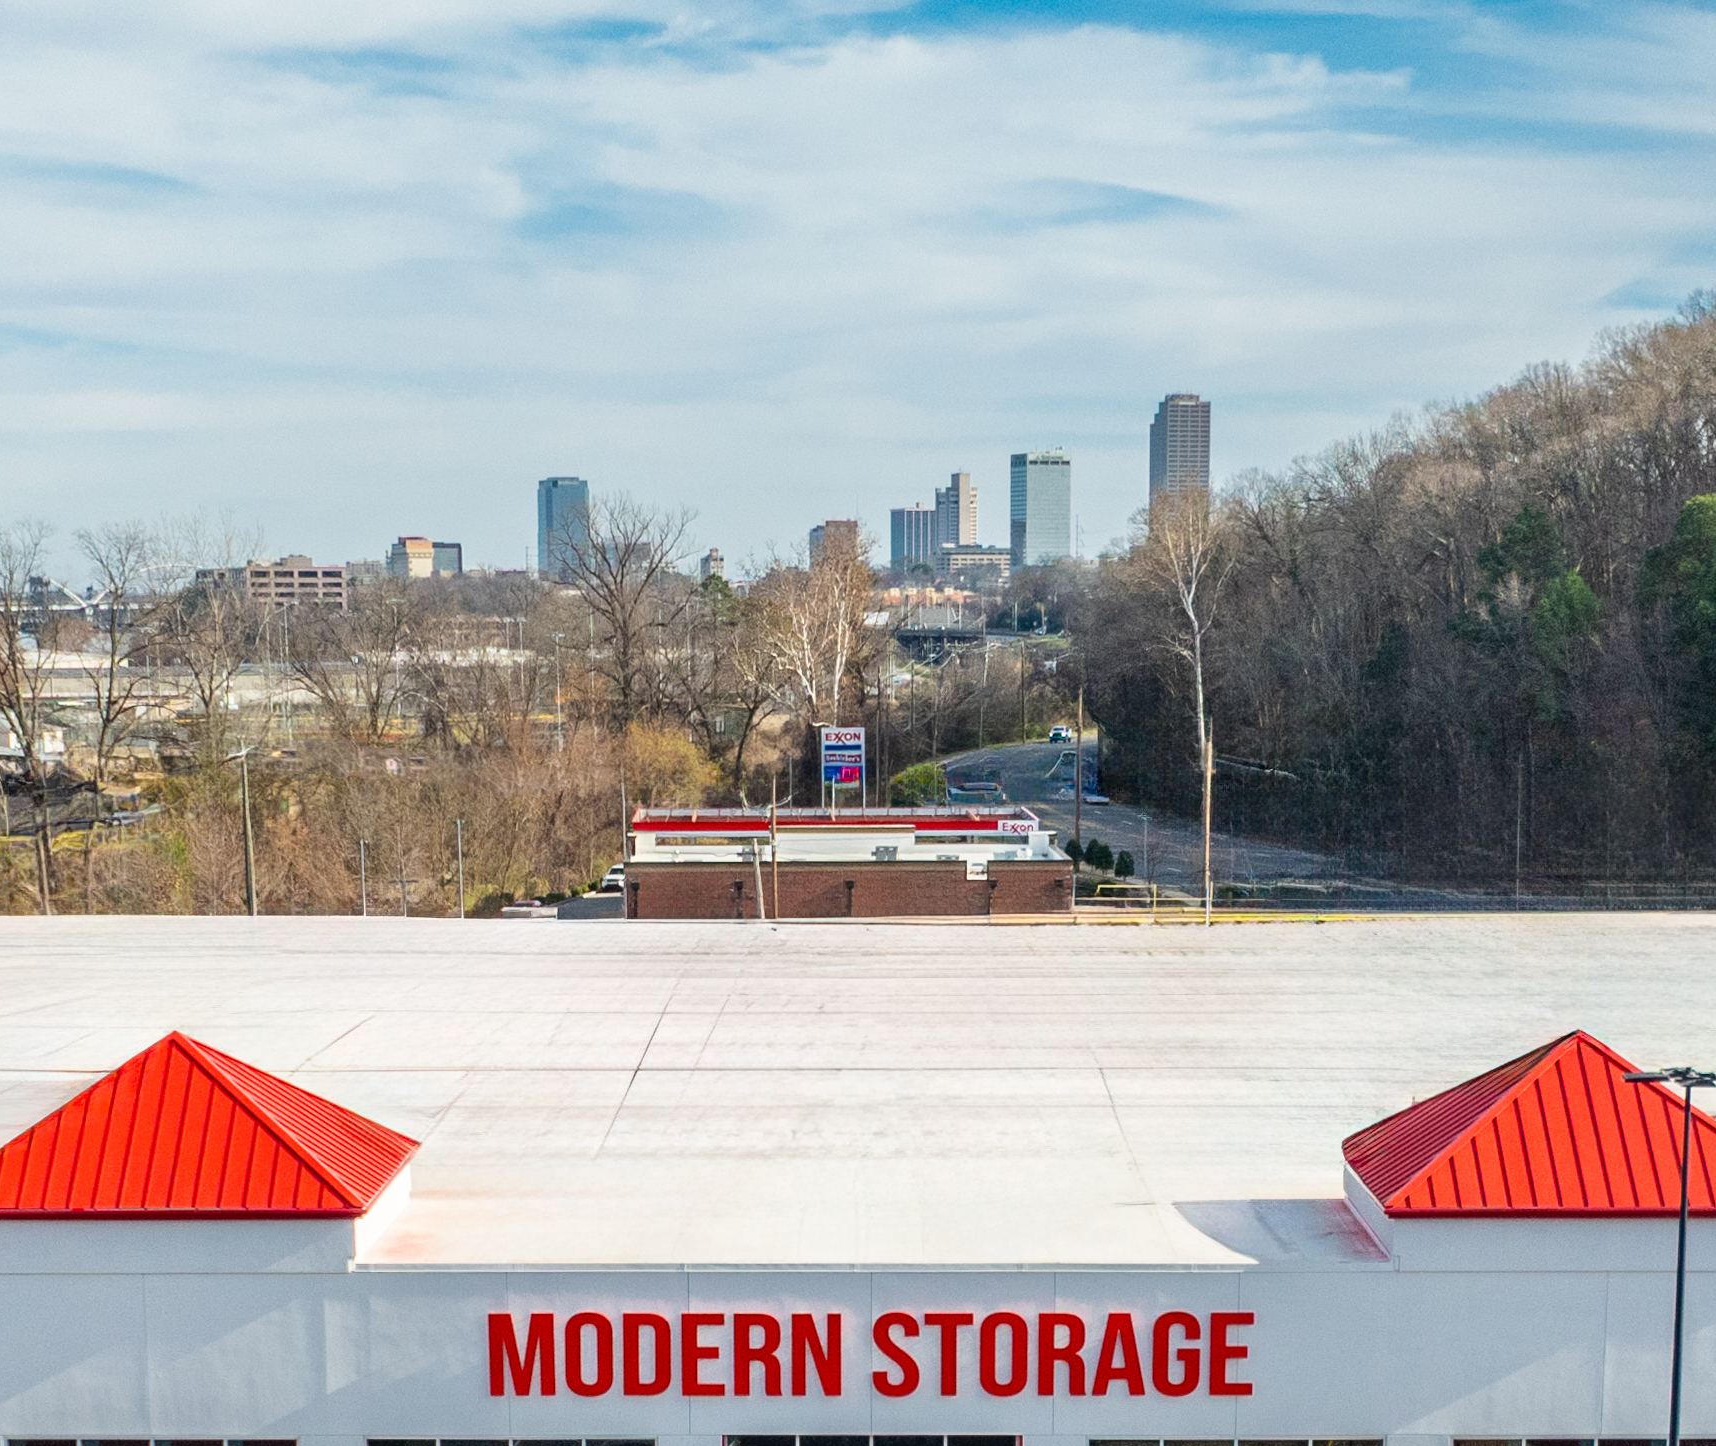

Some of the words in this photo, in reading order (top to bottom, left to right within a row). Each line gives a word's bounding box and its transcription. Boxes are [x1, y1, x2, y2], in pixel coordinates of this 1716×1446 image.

[825, 732, 861, 744] EXXON
[1002, 822, 1034, 835] Exxon
[488, 1312, 842, 1397] MODERN
[873, 1312, 1254, 1397] STORAGE
